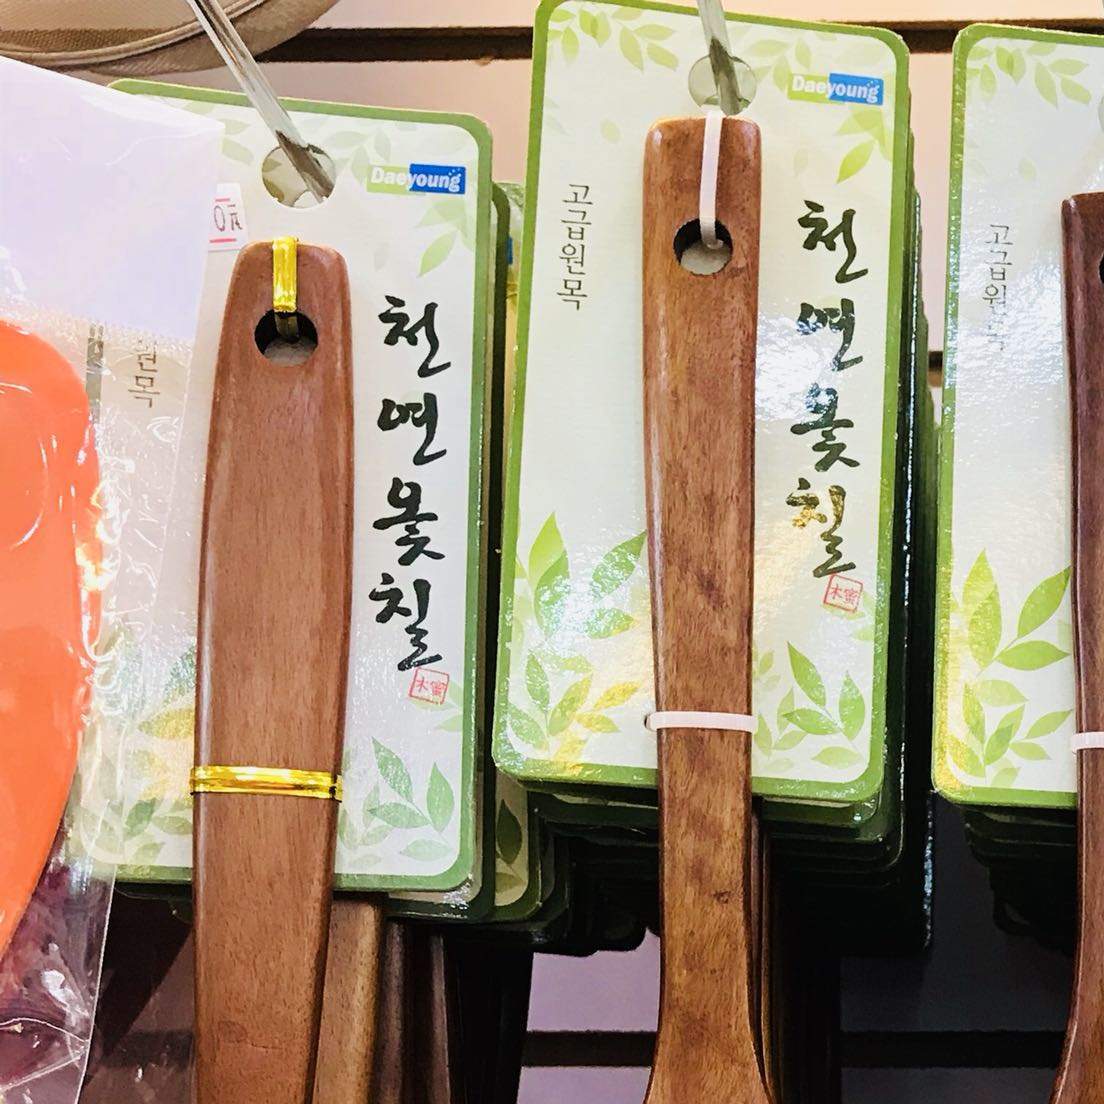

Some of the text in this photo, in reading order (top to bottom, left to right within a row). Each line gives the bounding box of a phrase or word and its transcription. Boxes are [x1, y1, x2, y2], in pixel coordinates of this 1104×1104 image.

[792, 74, 881, 104] Daeyoung
[371, 166, 462, 193] Daeyoung
[555, 183, 593, 311] 고급원목
